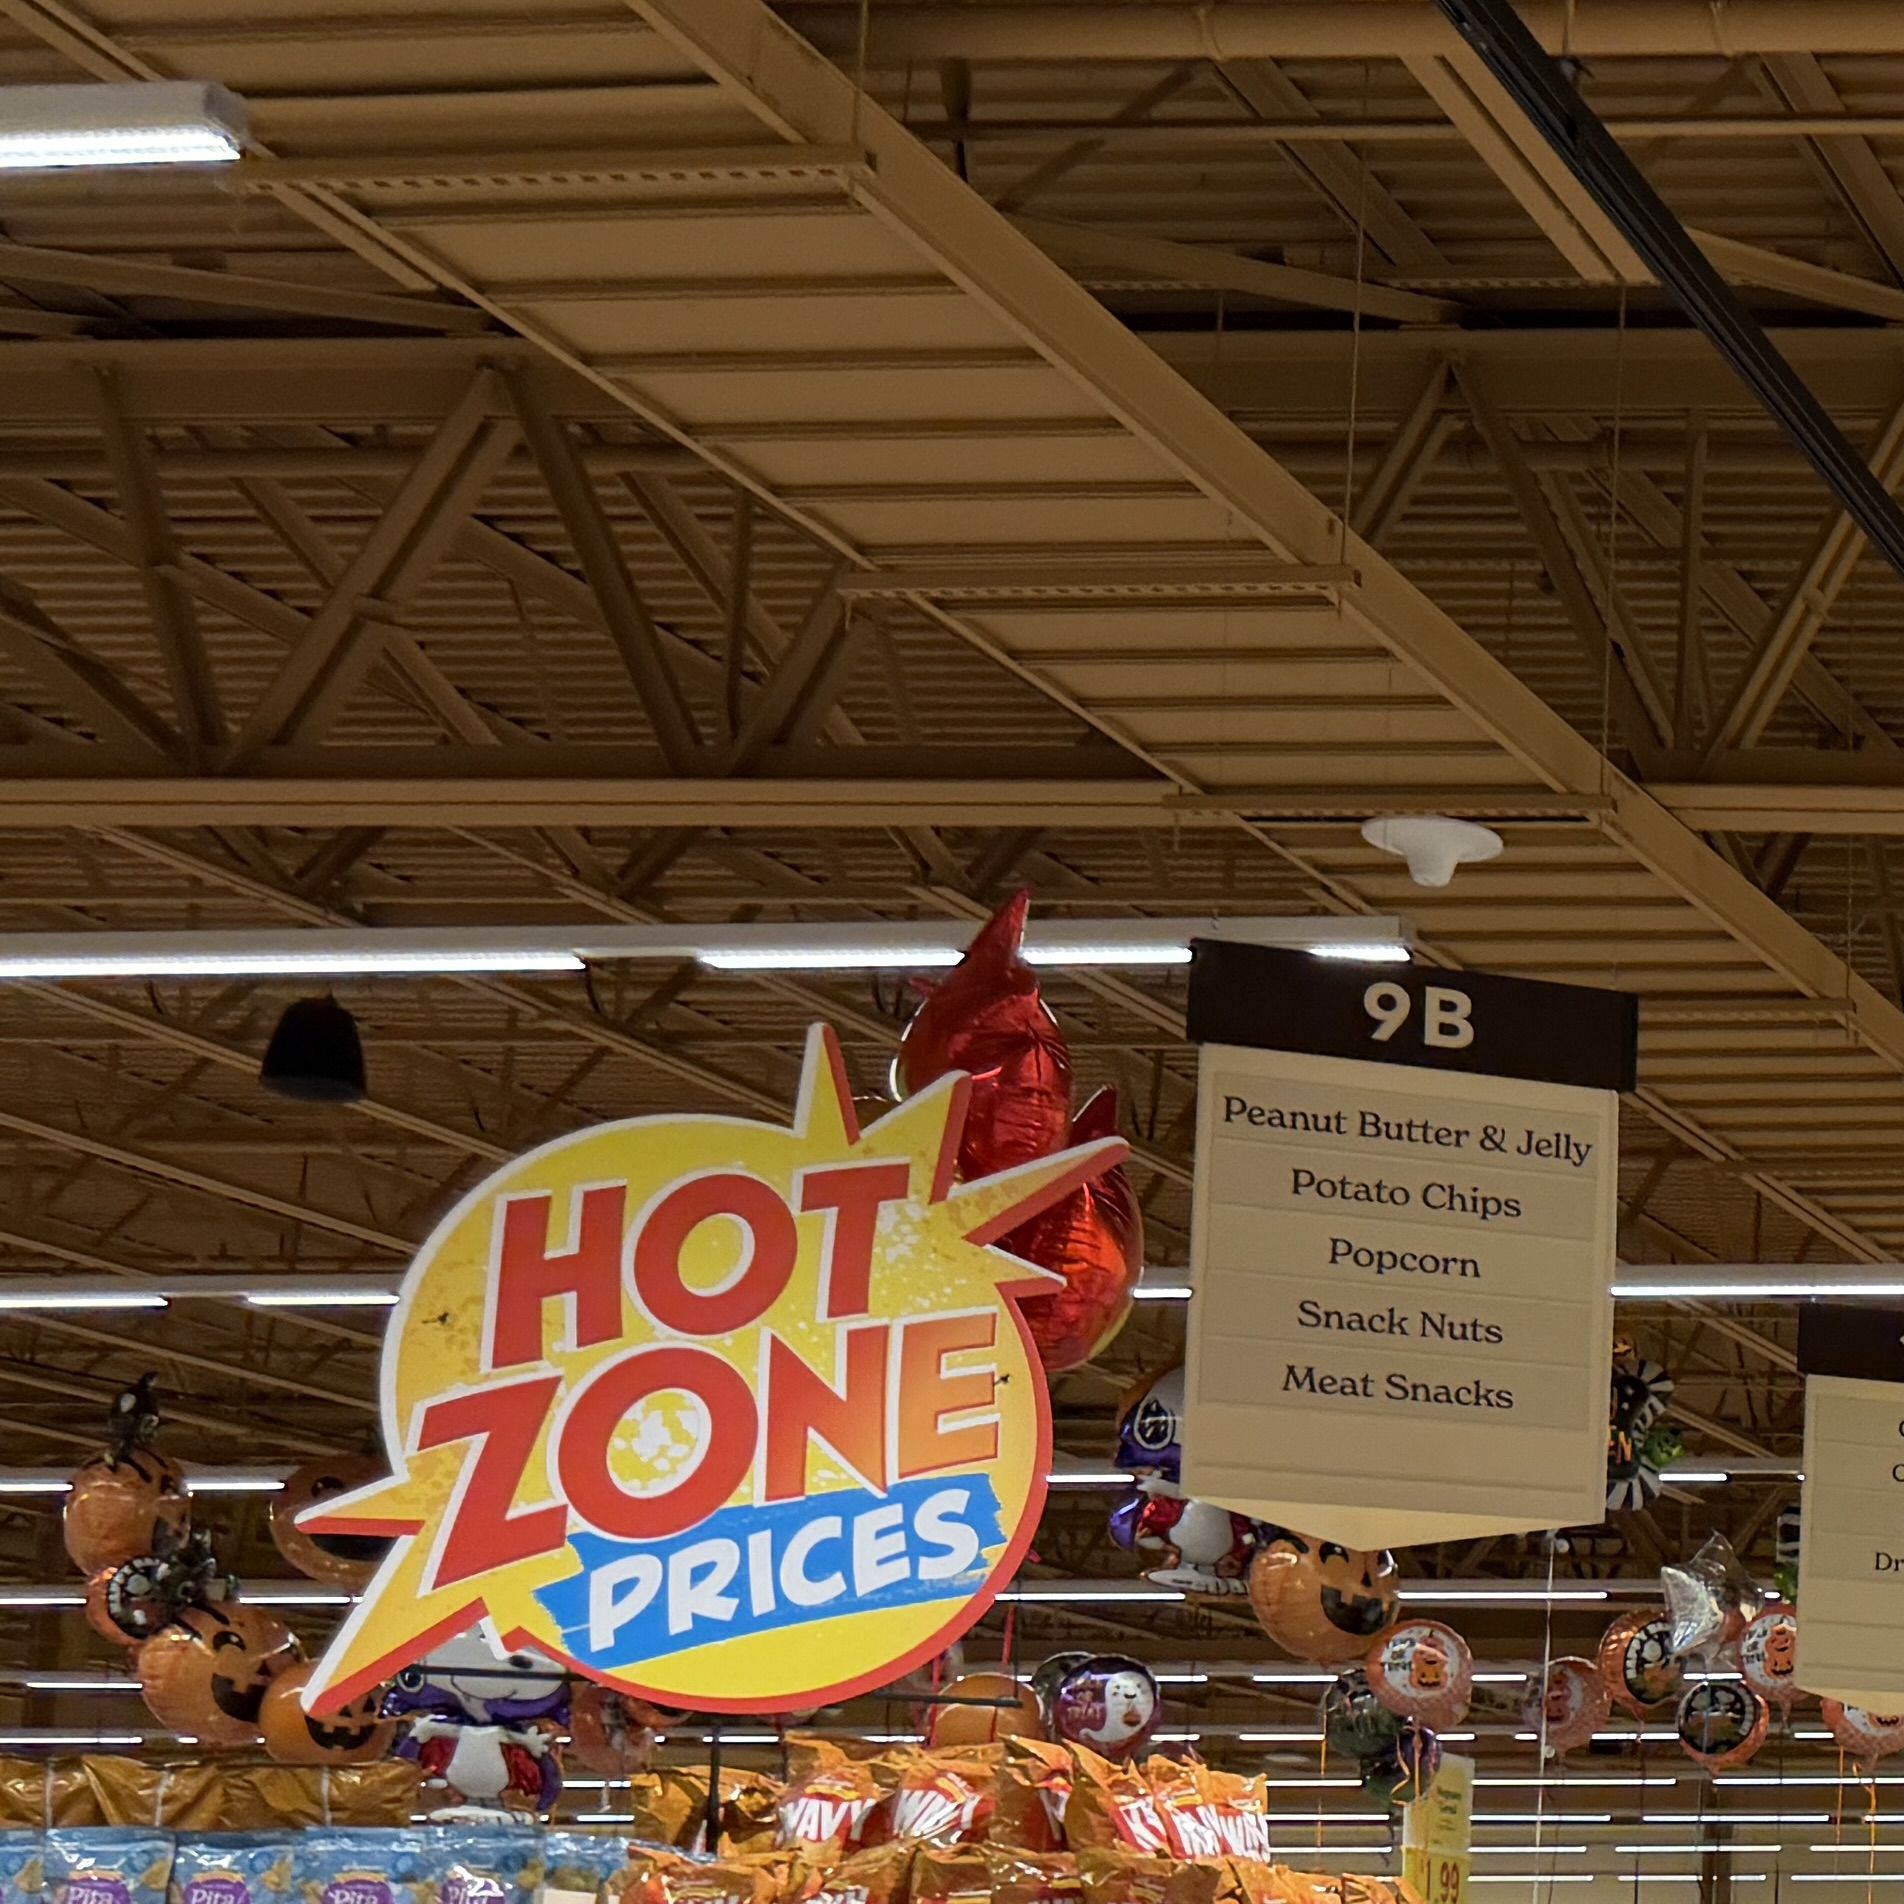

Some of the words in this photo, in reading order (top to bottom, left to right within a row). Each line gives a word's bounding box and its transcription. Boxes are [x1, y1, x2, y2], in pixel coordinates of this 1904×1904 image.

[1222, 1096, 1348, 1136] Peanut
[1358, 1112, 1469, 1150] Butter
[1479, 1125, 1507, 1153] &
[1518, 1129, 1592, 1167] Jelly
[1291, 1168, 1410, 1207] Potato
[1423, 1182, 1521, 1219] Chips
[491, 1162, 910, 1370] HOT
[1328, 1237, 1481, 1279] Popcorn
[1298, 1301, 1409, 1337] Snack
[1420, 1311, 1504, 1345] Nuts
[1282, 1364, 1375, 1400] Meat
[1385, 1374, 1514, 1410] Snacks
[417, 1313, 998, 1591] ZONE
[590, 1489, 980, 1653] PRICES
